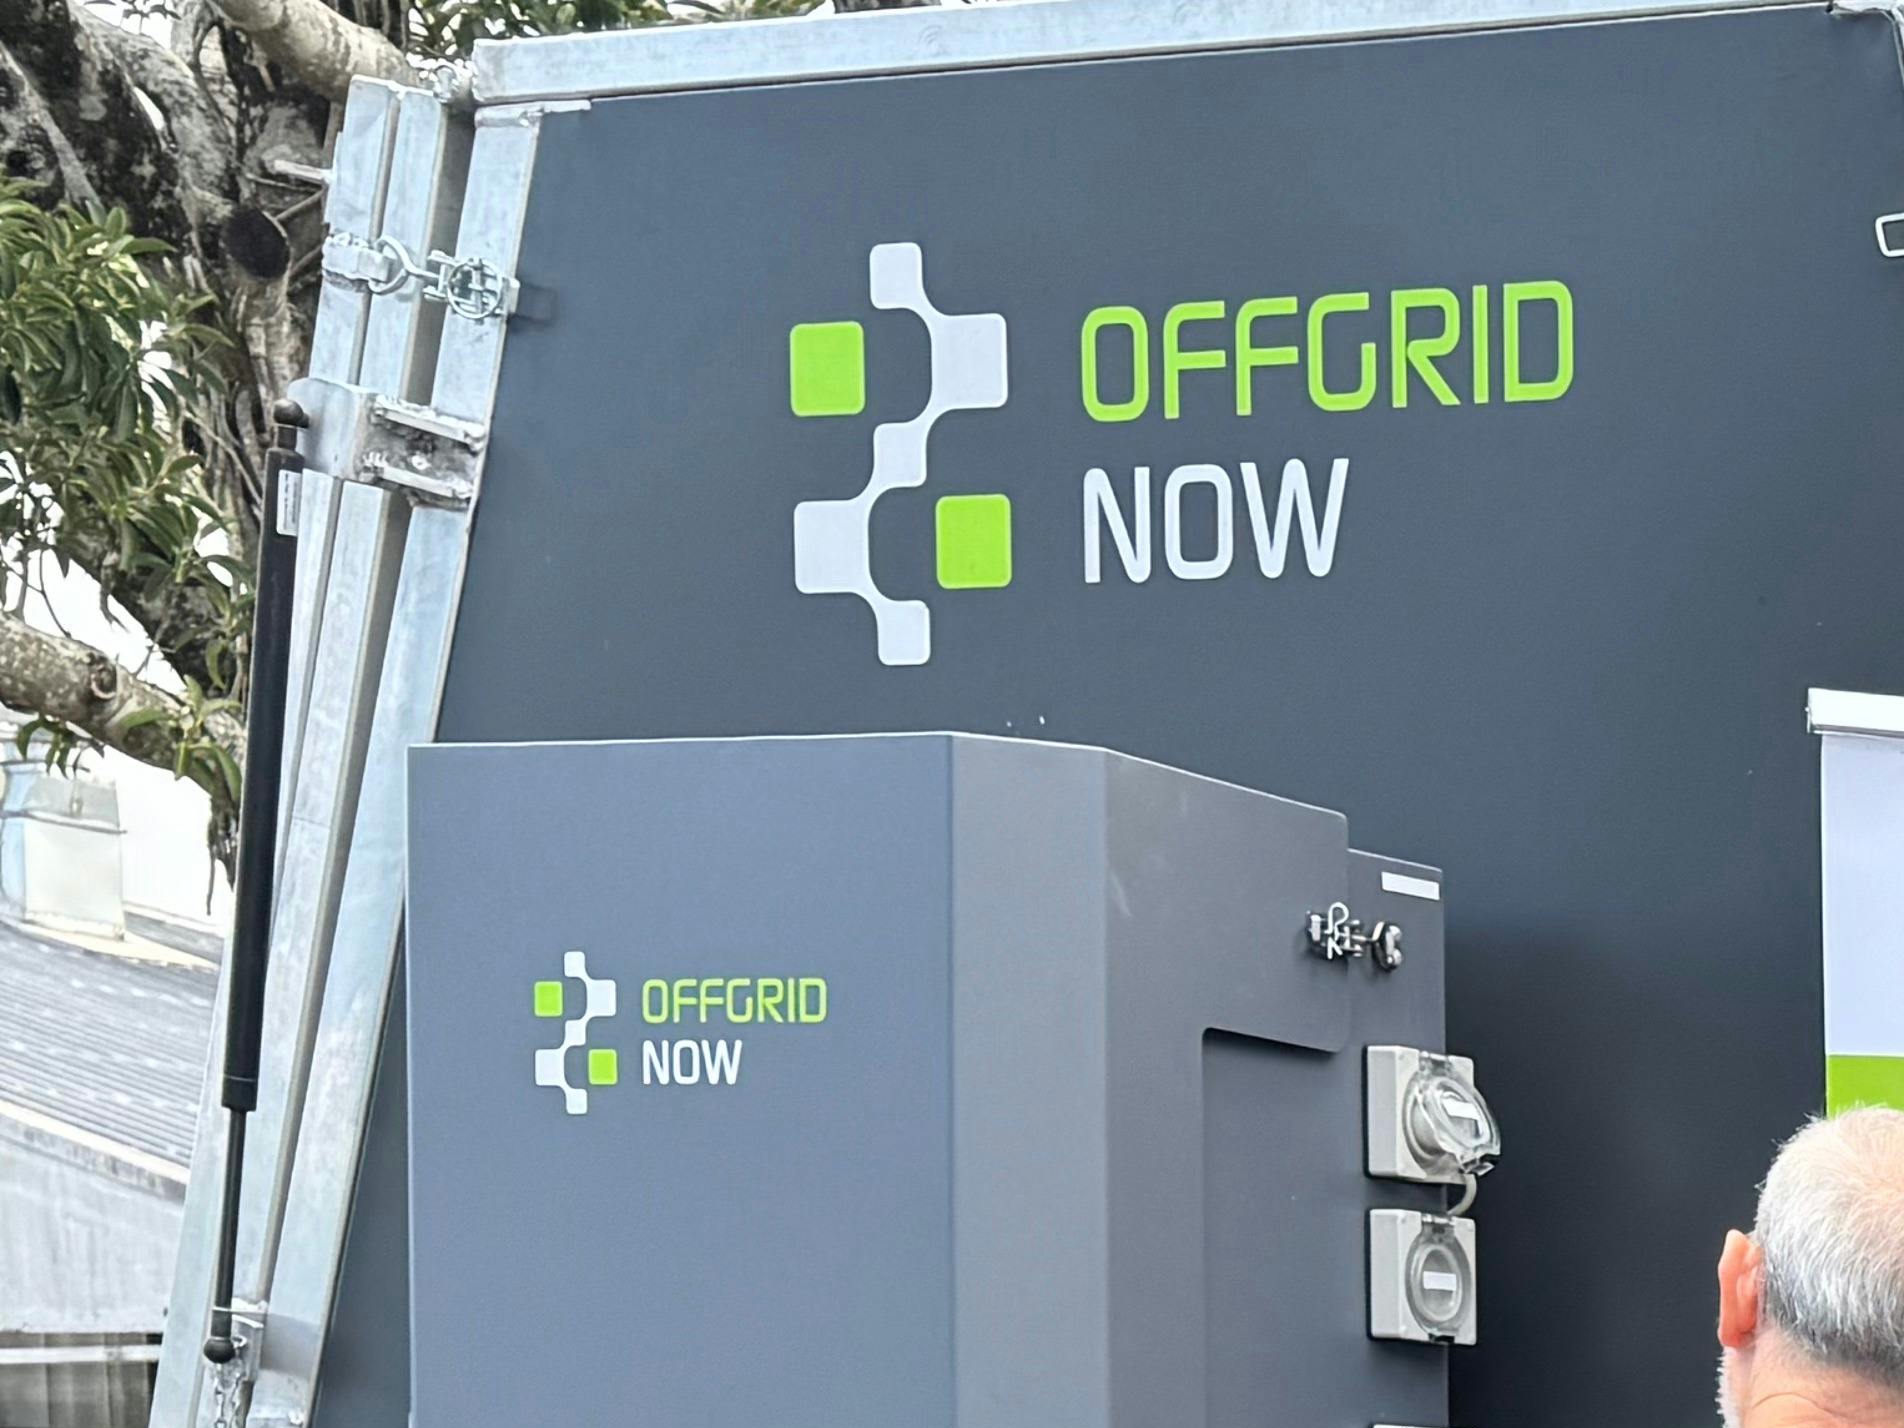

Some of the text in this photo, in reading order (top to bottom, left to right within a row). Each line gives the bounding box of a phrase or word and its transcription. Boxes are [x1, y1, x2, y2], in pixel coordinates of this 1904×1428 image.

[1081, 280, 1574, 423] OFFGRID
[1083, 457, 1349, 584] NOW
[642, 978, 827, 1023] OFFGRID
[642, 1039, 742, 1085] NOW
